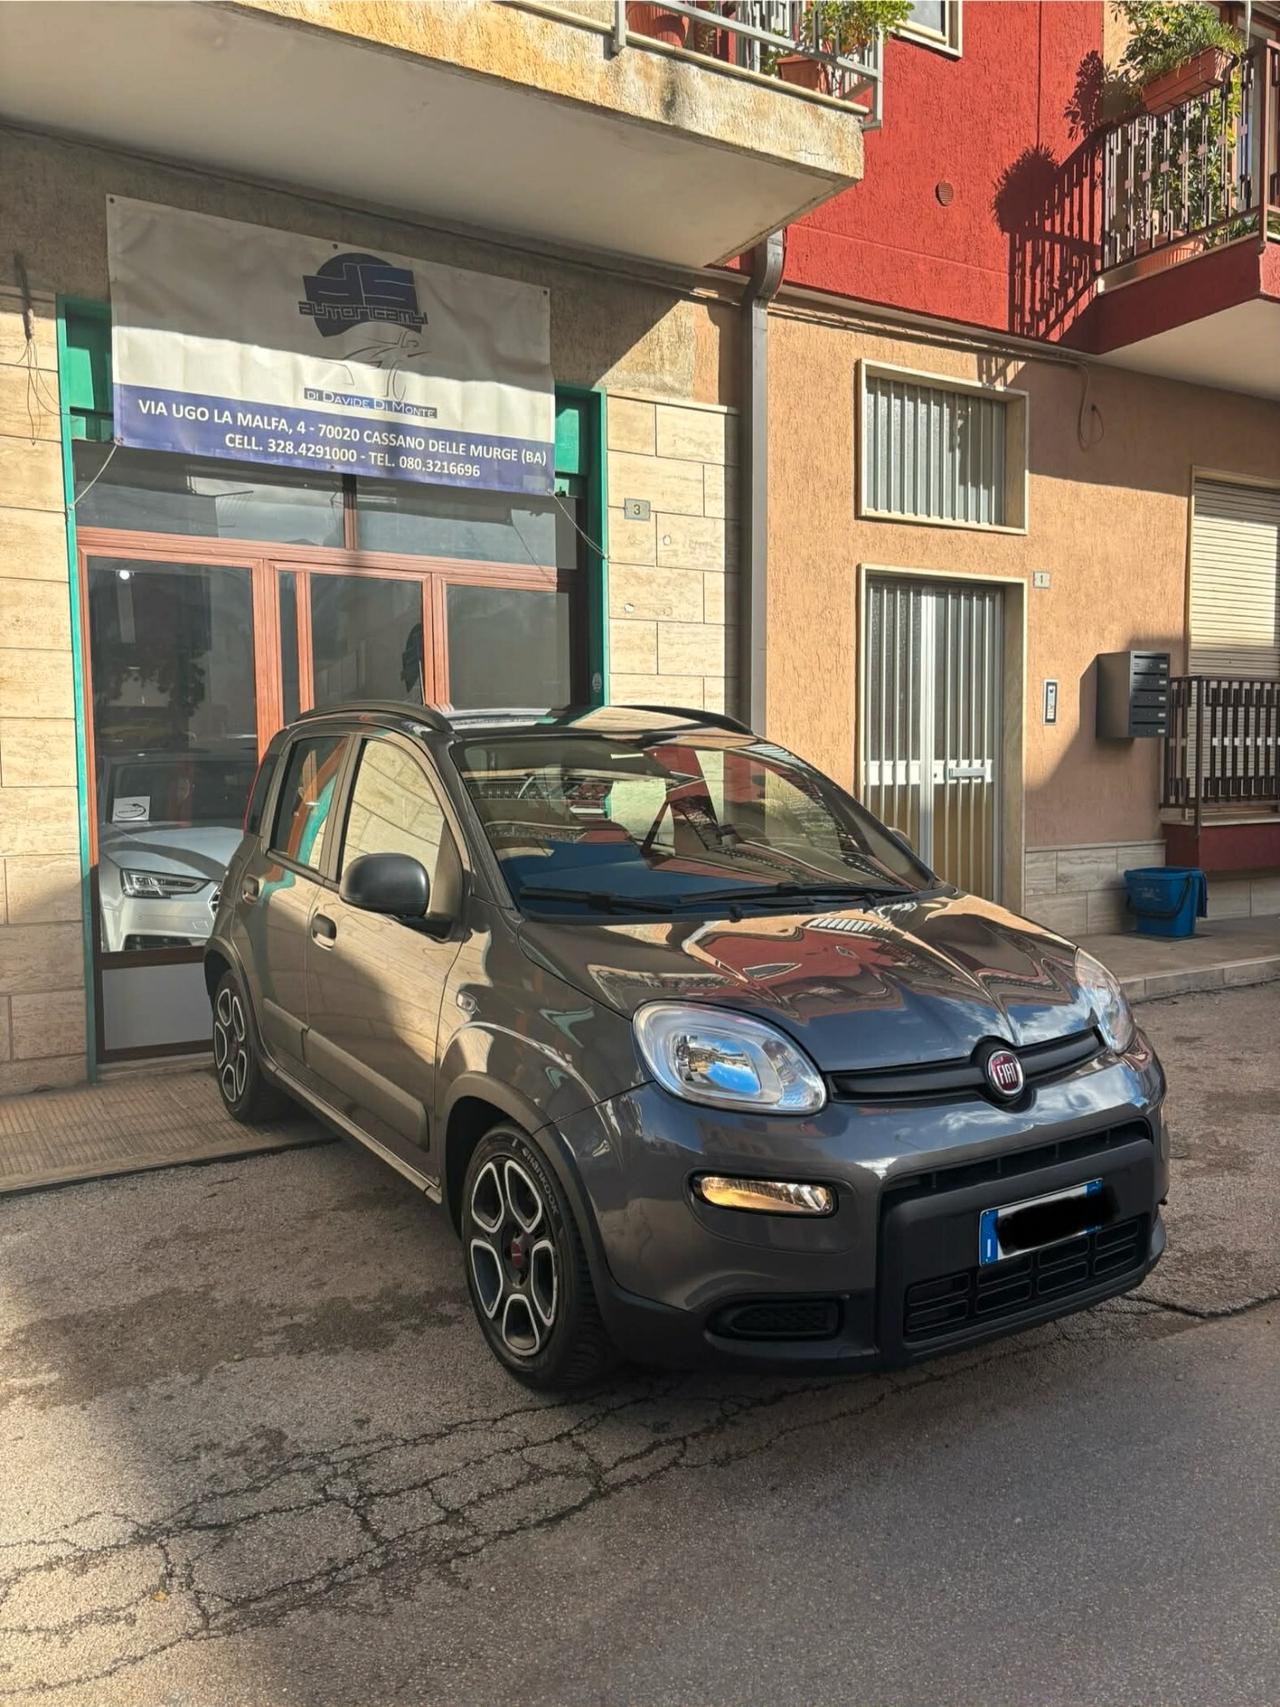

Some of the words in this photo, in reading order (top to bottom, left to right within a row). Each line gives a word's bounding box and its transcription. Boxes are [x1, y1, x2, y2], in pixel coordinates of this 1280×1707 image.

[138, 399, 168, 416] VIA
[172, 403, 209, 421] UGO
[214, 409, 233, 425] LA
[237, 414, 293, 435] MALFA,
[296, 421, 306, 434] 4
[318, 424, 360, 441] 70020
[363, 430, 425, 450] CASSANO
[428, 440, 466, 455] DELLE
[469, 445, 518, 461] MURGE
[521, 449, 547, 466] (BA)
[225, 433, 263, 451] CELL.
[267, 438, 357, 462] 328.4291000
[368, 452, 395, 467] TEL.
[399, 456, 480, 477] 080.3216696
[633, 503, 641, 515] 3
[996, 1062, 1017, 1085] FIAT
